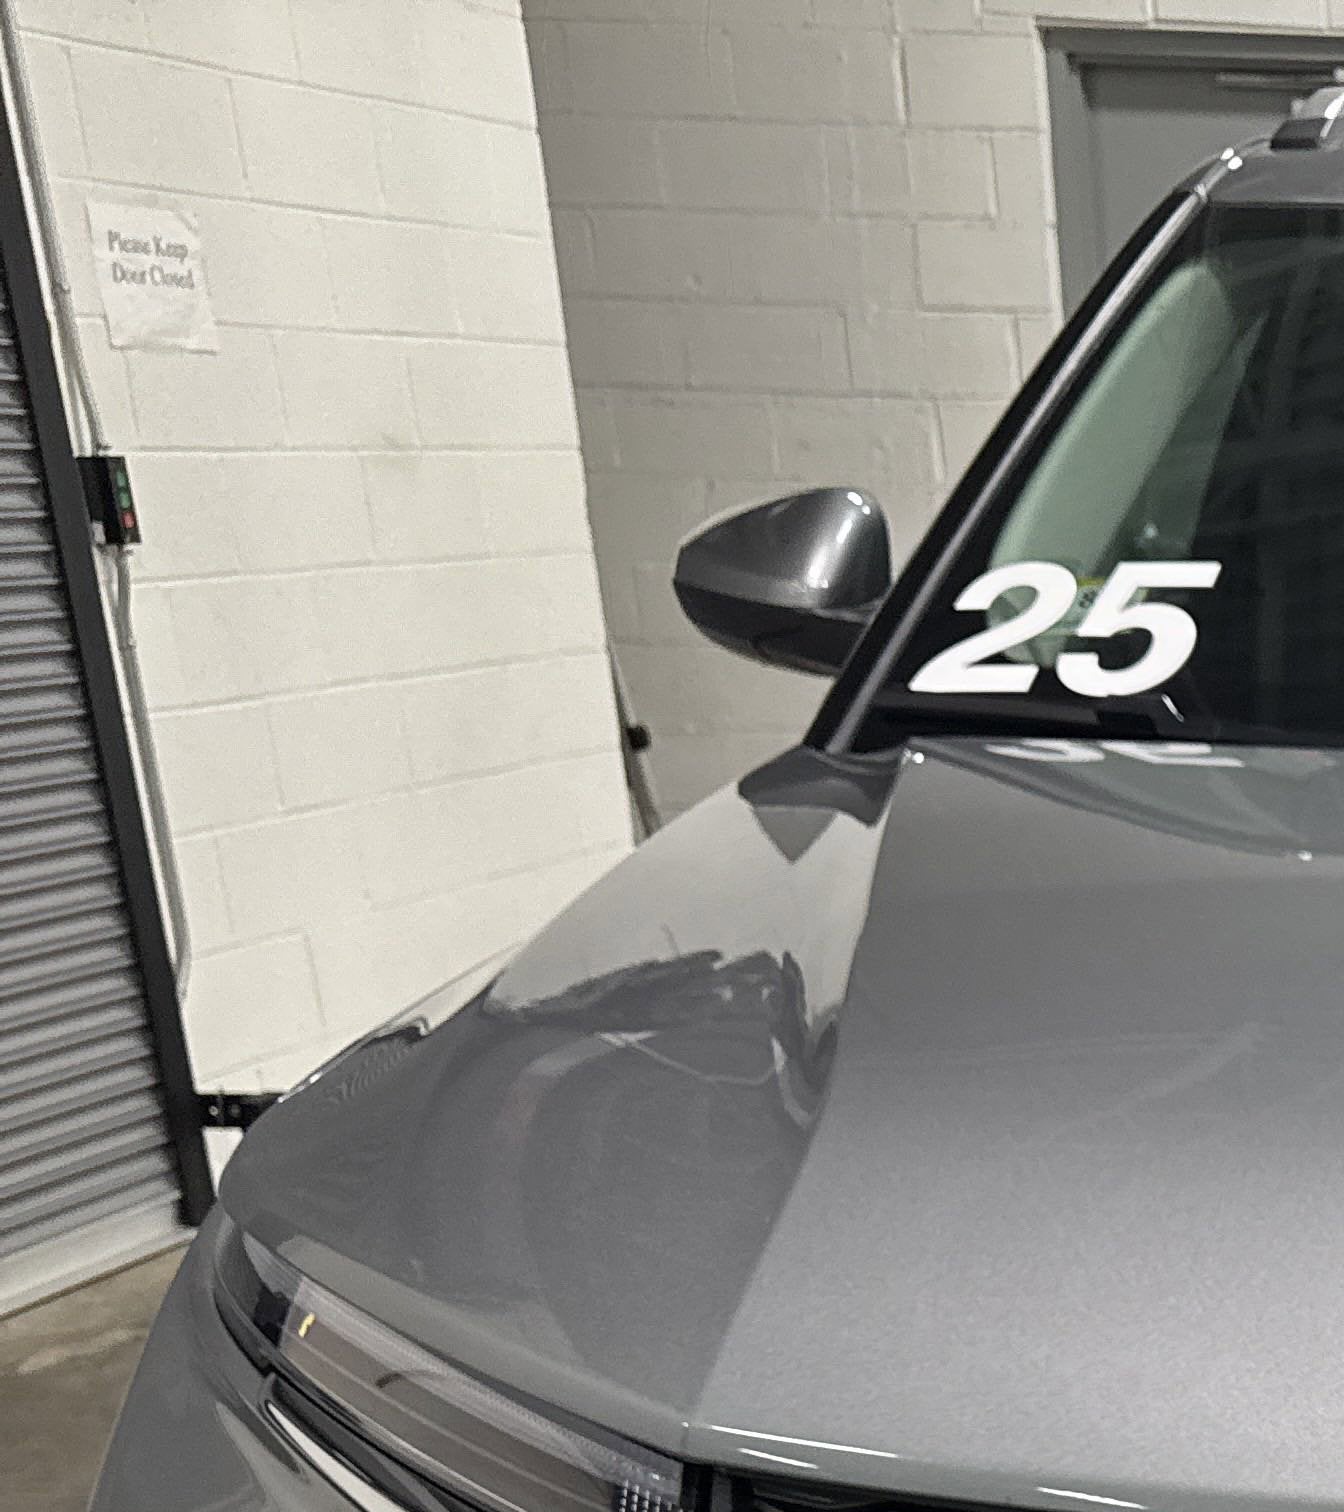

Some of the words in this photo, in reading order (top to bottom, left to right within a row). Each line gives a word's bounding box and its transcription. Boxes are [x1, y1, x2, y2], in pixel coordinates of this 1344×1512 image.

[107, 230, 151, 256] Please
[152, 235, 188, 264] Keep
[111, 261, 147, 284] Door
[149, 262, 195, 290] Closed
[908, 560, 1222, 698] 25
